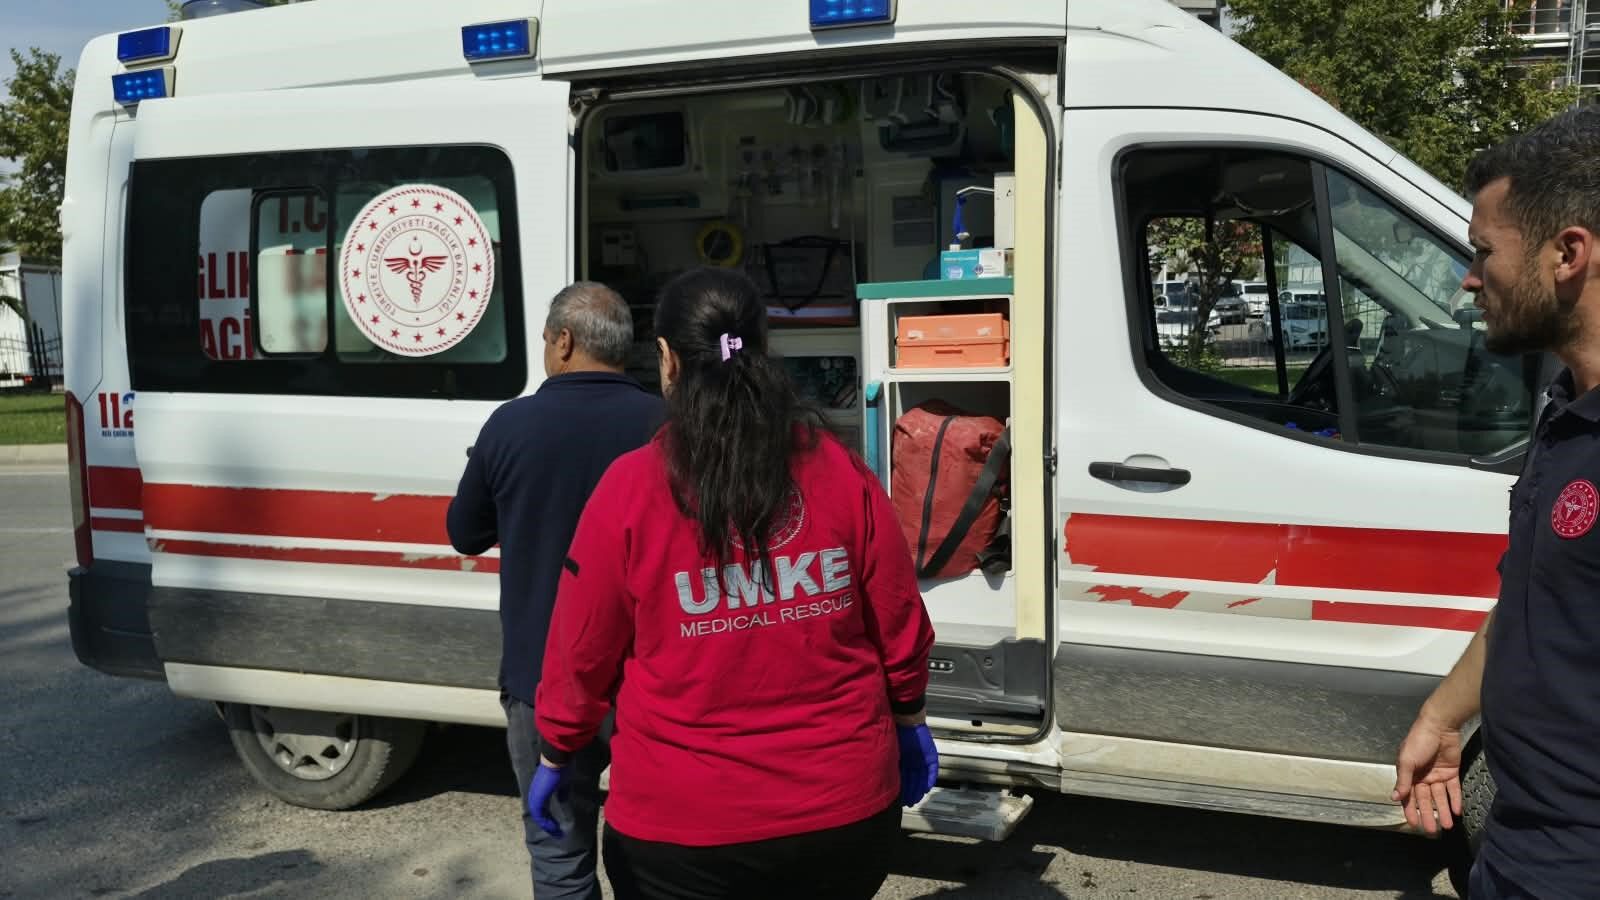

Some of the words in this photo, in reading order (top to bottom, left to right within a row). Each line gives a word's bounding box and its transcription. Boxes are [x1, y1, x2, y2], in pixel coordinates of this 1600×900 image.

[428, 221, 458, 250] SAĞLIK
[438, 253, 464, 314] BAKANLIĞI
[674, 546, 851, 615] UMKE
[680, 611, 777, 638] MEDICAL
[779, 592, 854, 623] RESCUE
